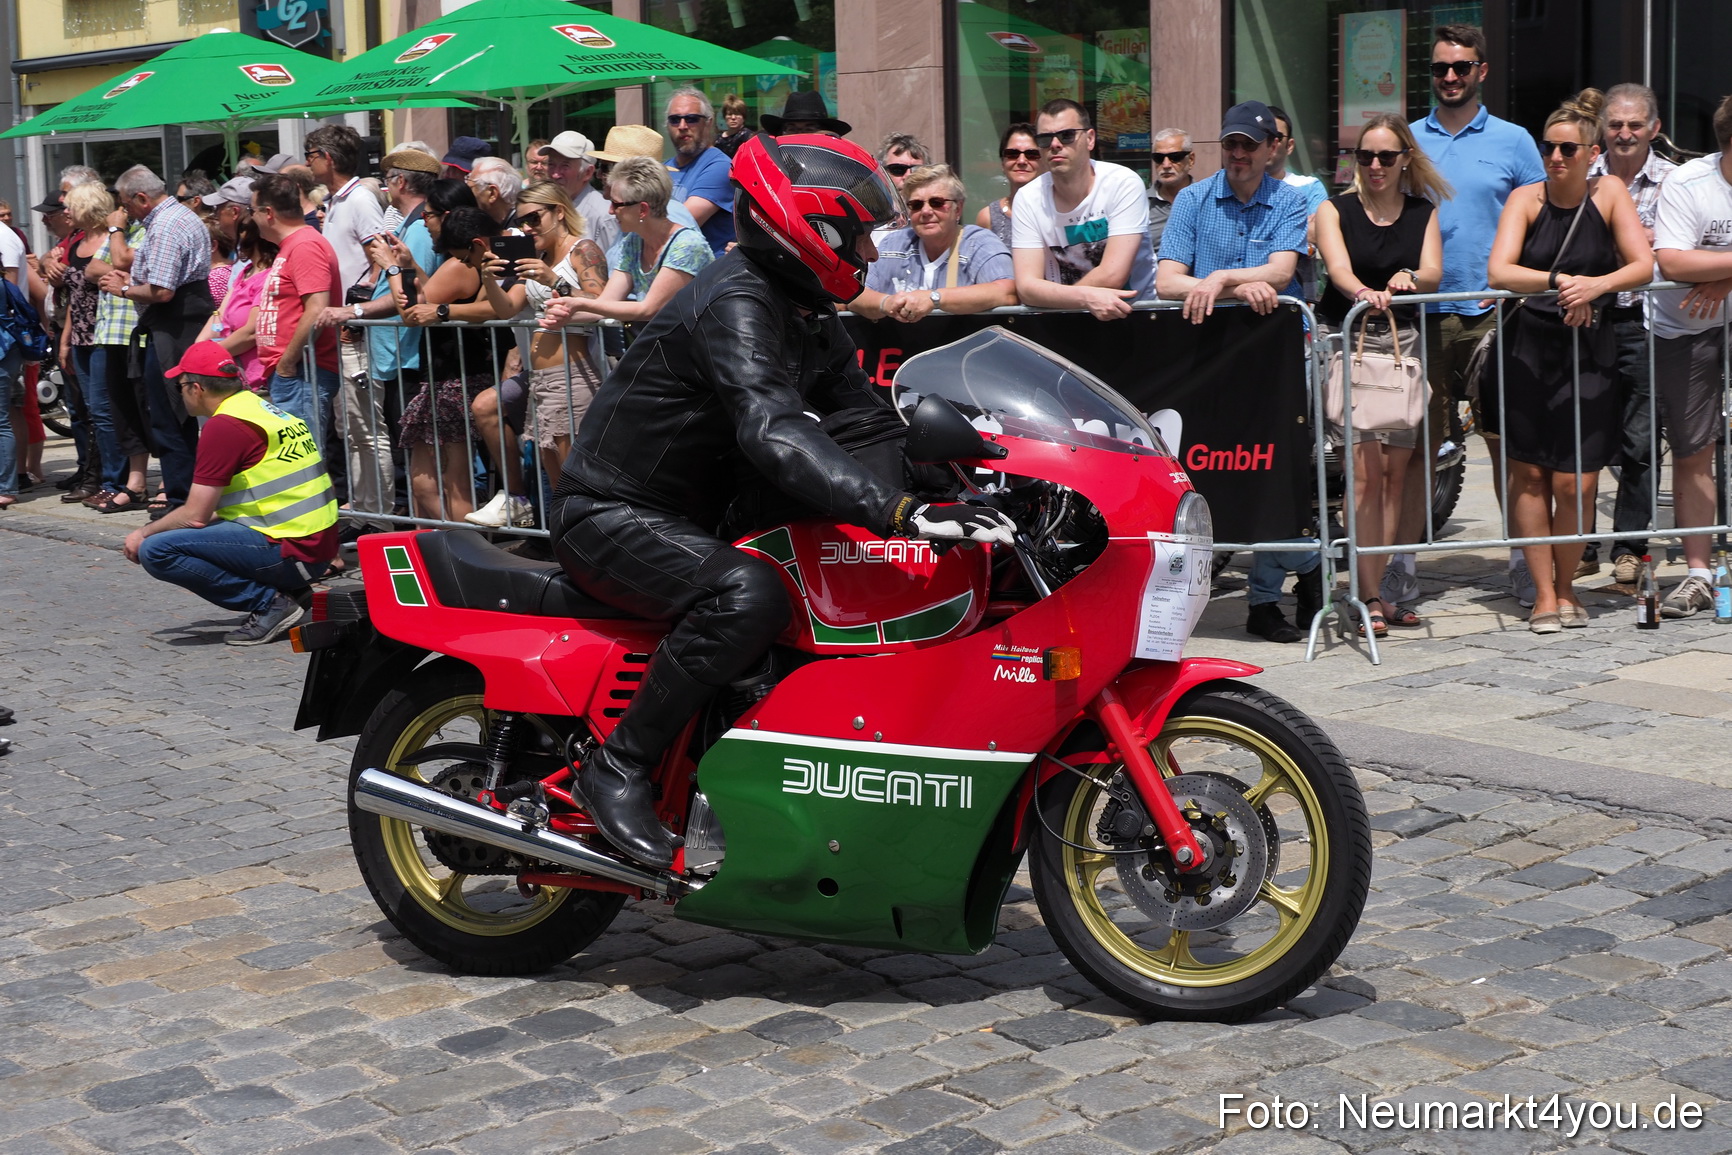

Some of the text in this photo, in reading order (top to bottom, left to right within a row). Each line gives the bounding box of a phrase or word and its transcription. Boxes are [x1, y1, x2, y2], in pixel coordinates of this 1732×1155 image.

[566, 51, 666, 62] Neumarkter
[1103, 38, 1147, 55] Grillen
[354, 66, 431, 80] Neumarkter
[559, 60, 703, 75] Lammsbräu
[316, 75, 427, 96] Lammsbräu
[755, 214, 776, 235] SHARK
[818, 221, 831, 244] SHARK
[1186, 443, 1275, 471] GmbH
[820, 540, 939, 565] DUCATI
[993, 643, 1040, 654] Mike Hailwood
[993, 664, 1037, 683] Mille
[782, 757, 973, 809] DUCATI
